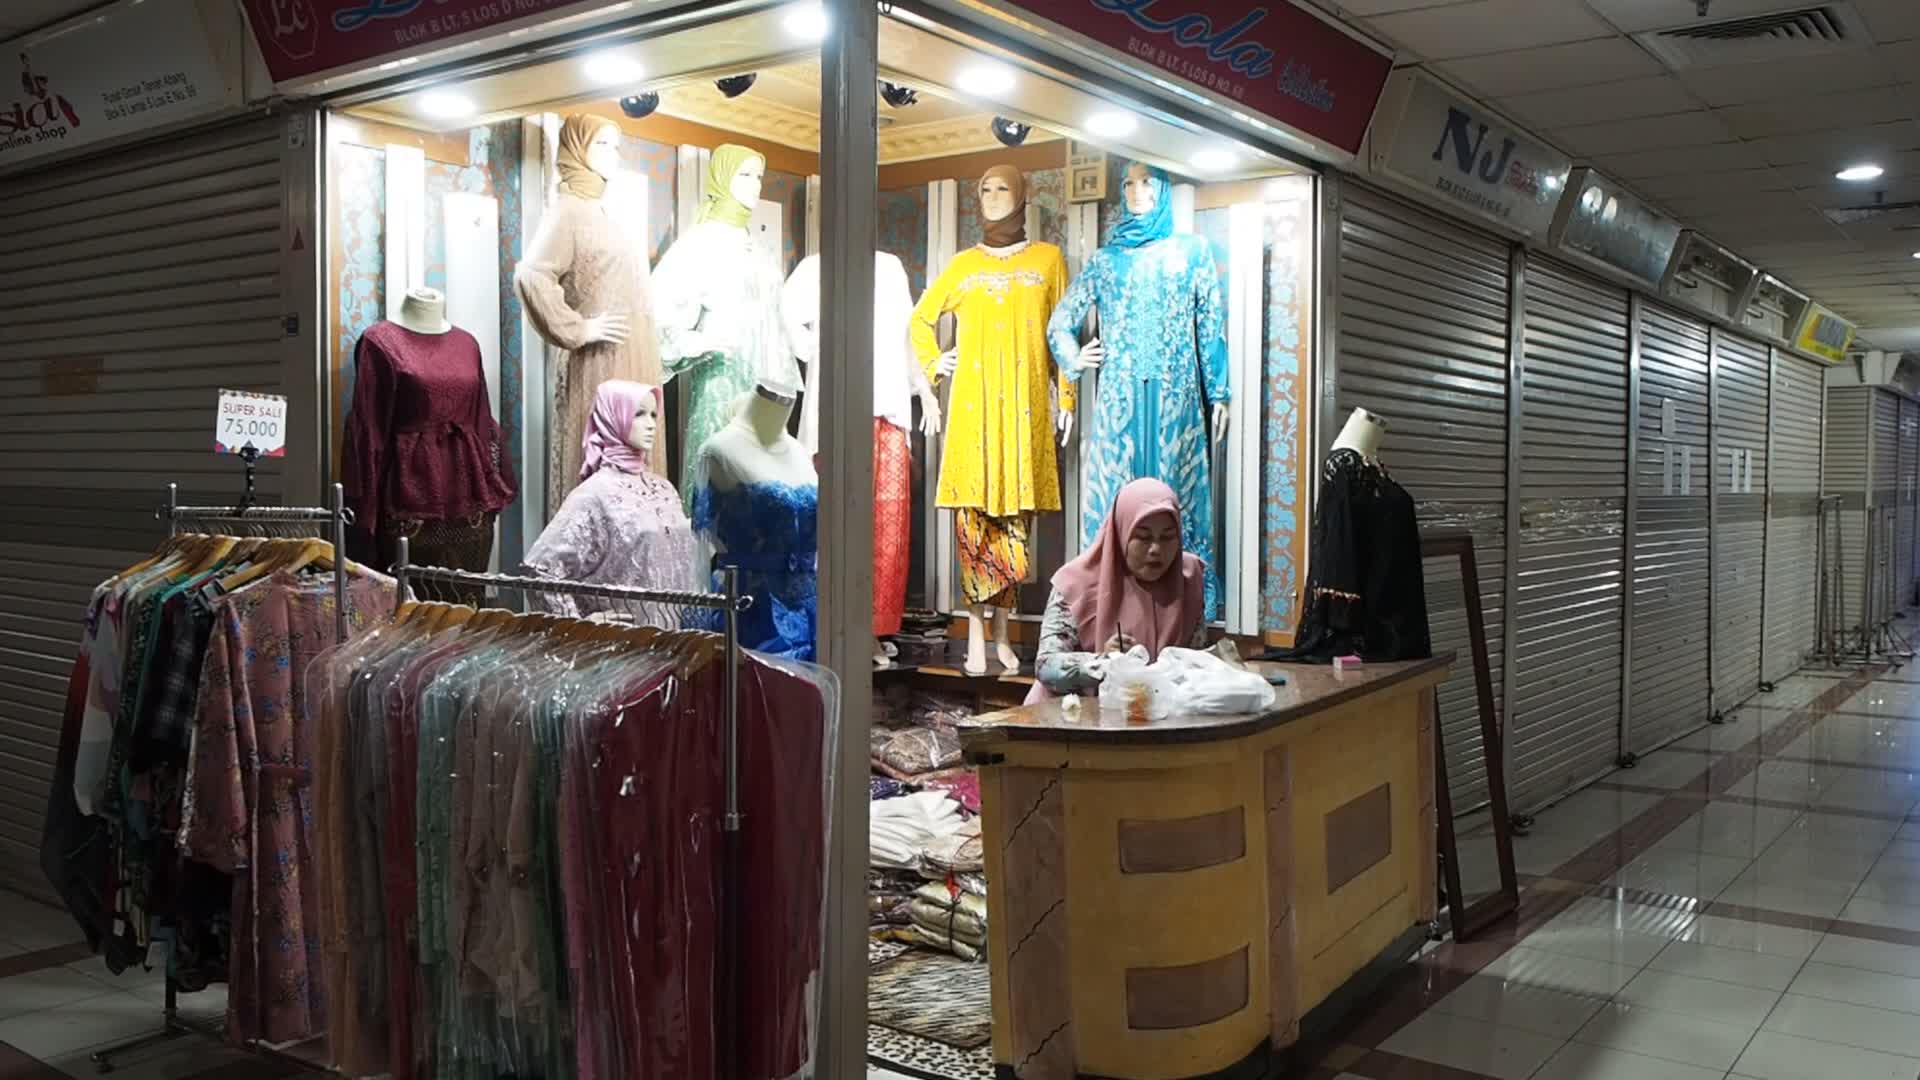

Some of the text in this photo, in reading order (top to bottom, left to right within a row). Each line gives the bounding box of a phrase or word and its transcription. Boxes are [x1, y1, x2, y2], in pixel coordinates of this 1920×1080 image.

[393, 23, 426, 43] BLOK
[429, 19, 441, 34] B
[471, 2, 500, 24] LOS
[1128, 36, 1156, 60] BLOK
[1189, 61, 1208, 83] LOS
[35, 125, 68, 143] shop
[1432, 105, 1516, 185] NJ
[223, 402, 256, 416] SUPER
[224, 417, 278, 438] 75.000
